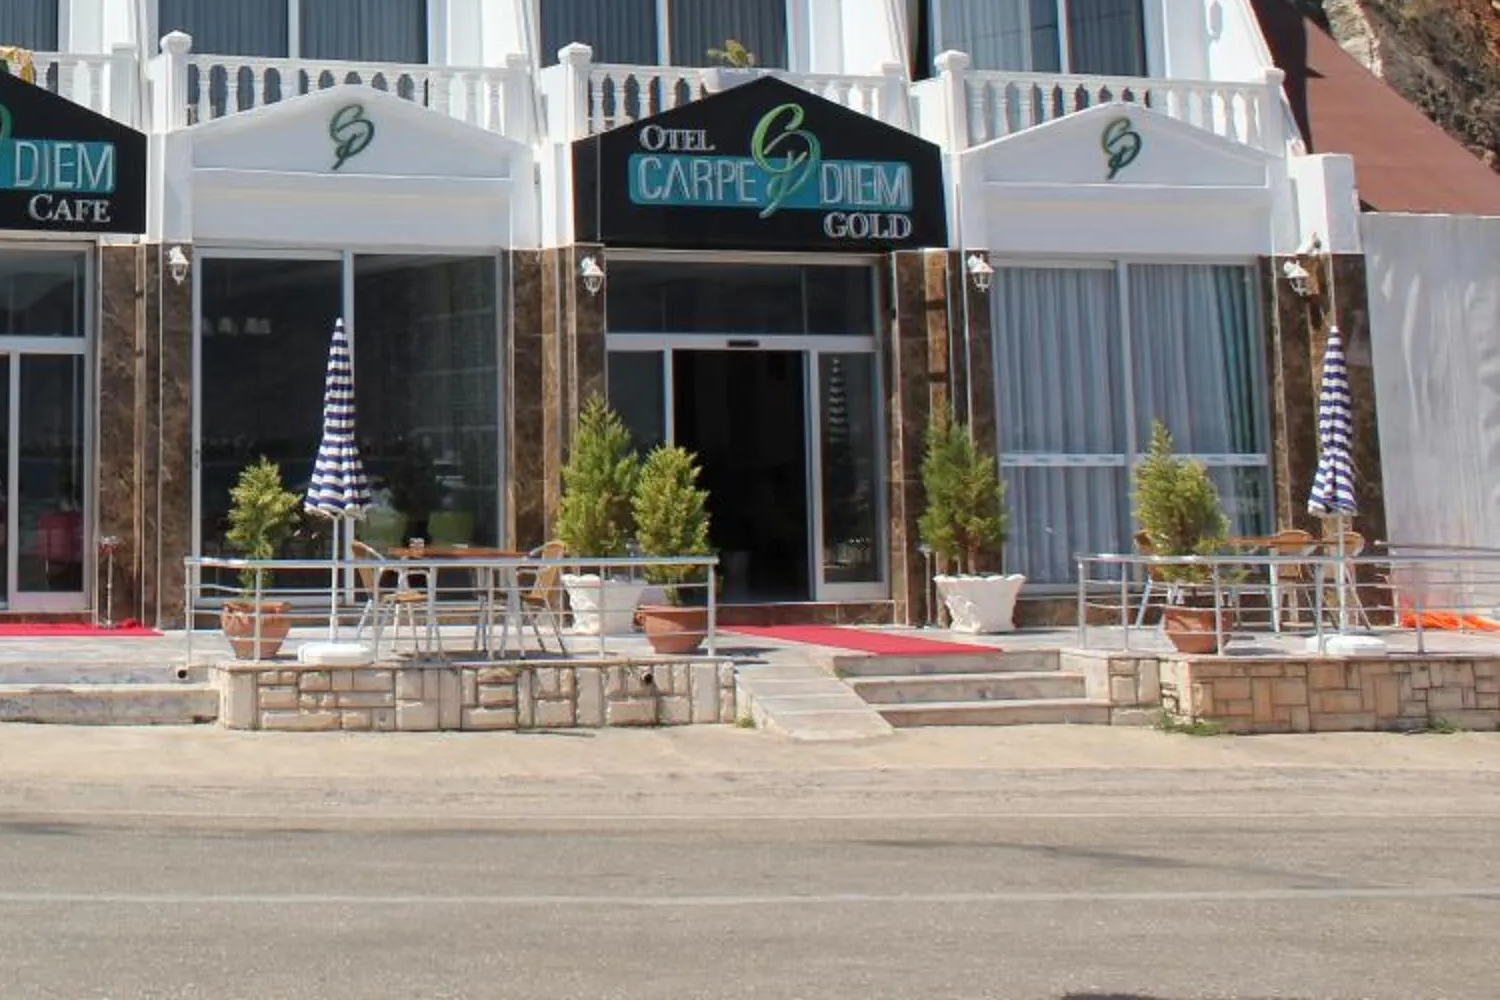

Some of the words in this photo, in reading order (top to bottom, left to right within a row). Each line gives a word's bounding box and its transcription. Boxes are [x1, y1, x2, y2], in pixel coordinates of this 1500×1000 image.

[639, 124, 716, 151] OTEL
[14, 139, 114, 191] DIEM
[637, 156, 757, 202] CARPE
[820, 162, 910, 207] DIEM
[28, 193, 111, 223] CAFE
[823, 213, 912, 240] GOLD
